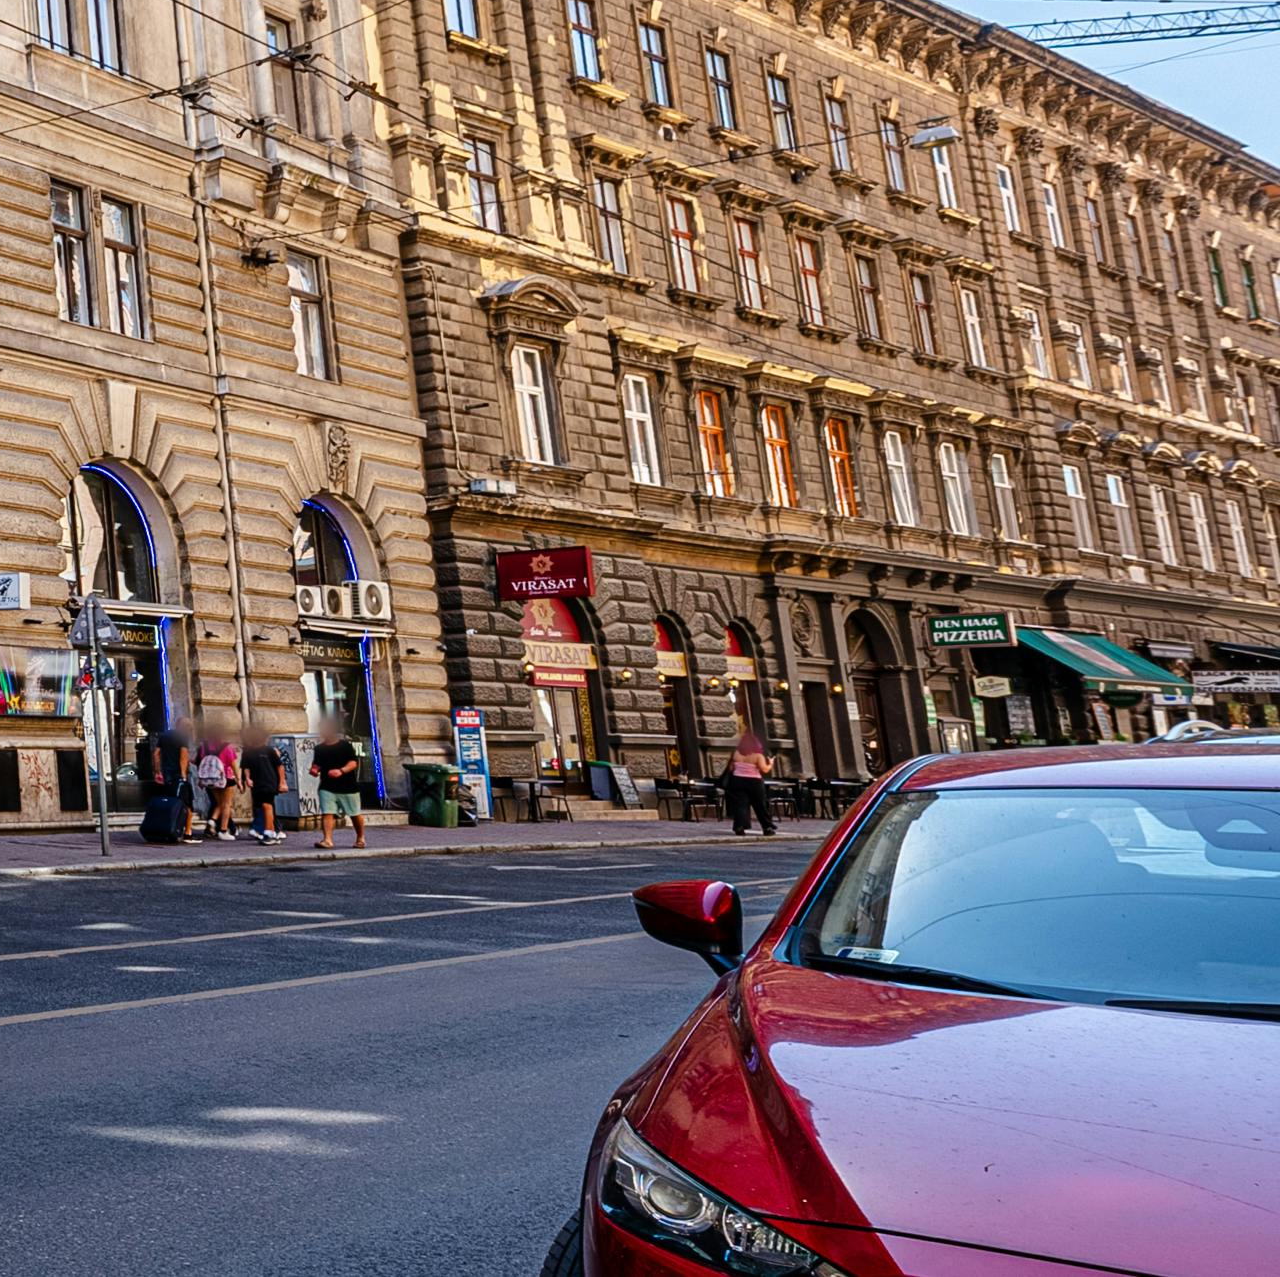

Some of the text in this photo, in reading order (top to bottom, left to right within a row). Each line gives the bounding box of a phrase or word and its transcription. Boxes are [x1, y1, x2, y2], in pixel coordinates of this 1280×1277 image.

[511, 578, 577, 591] VIRASAT
[934, 618, 998, 628] DEN HAAG
[933, 629, 1005, 642] PIZZERIA
[526, 644, 590, 666] VIRASAT
